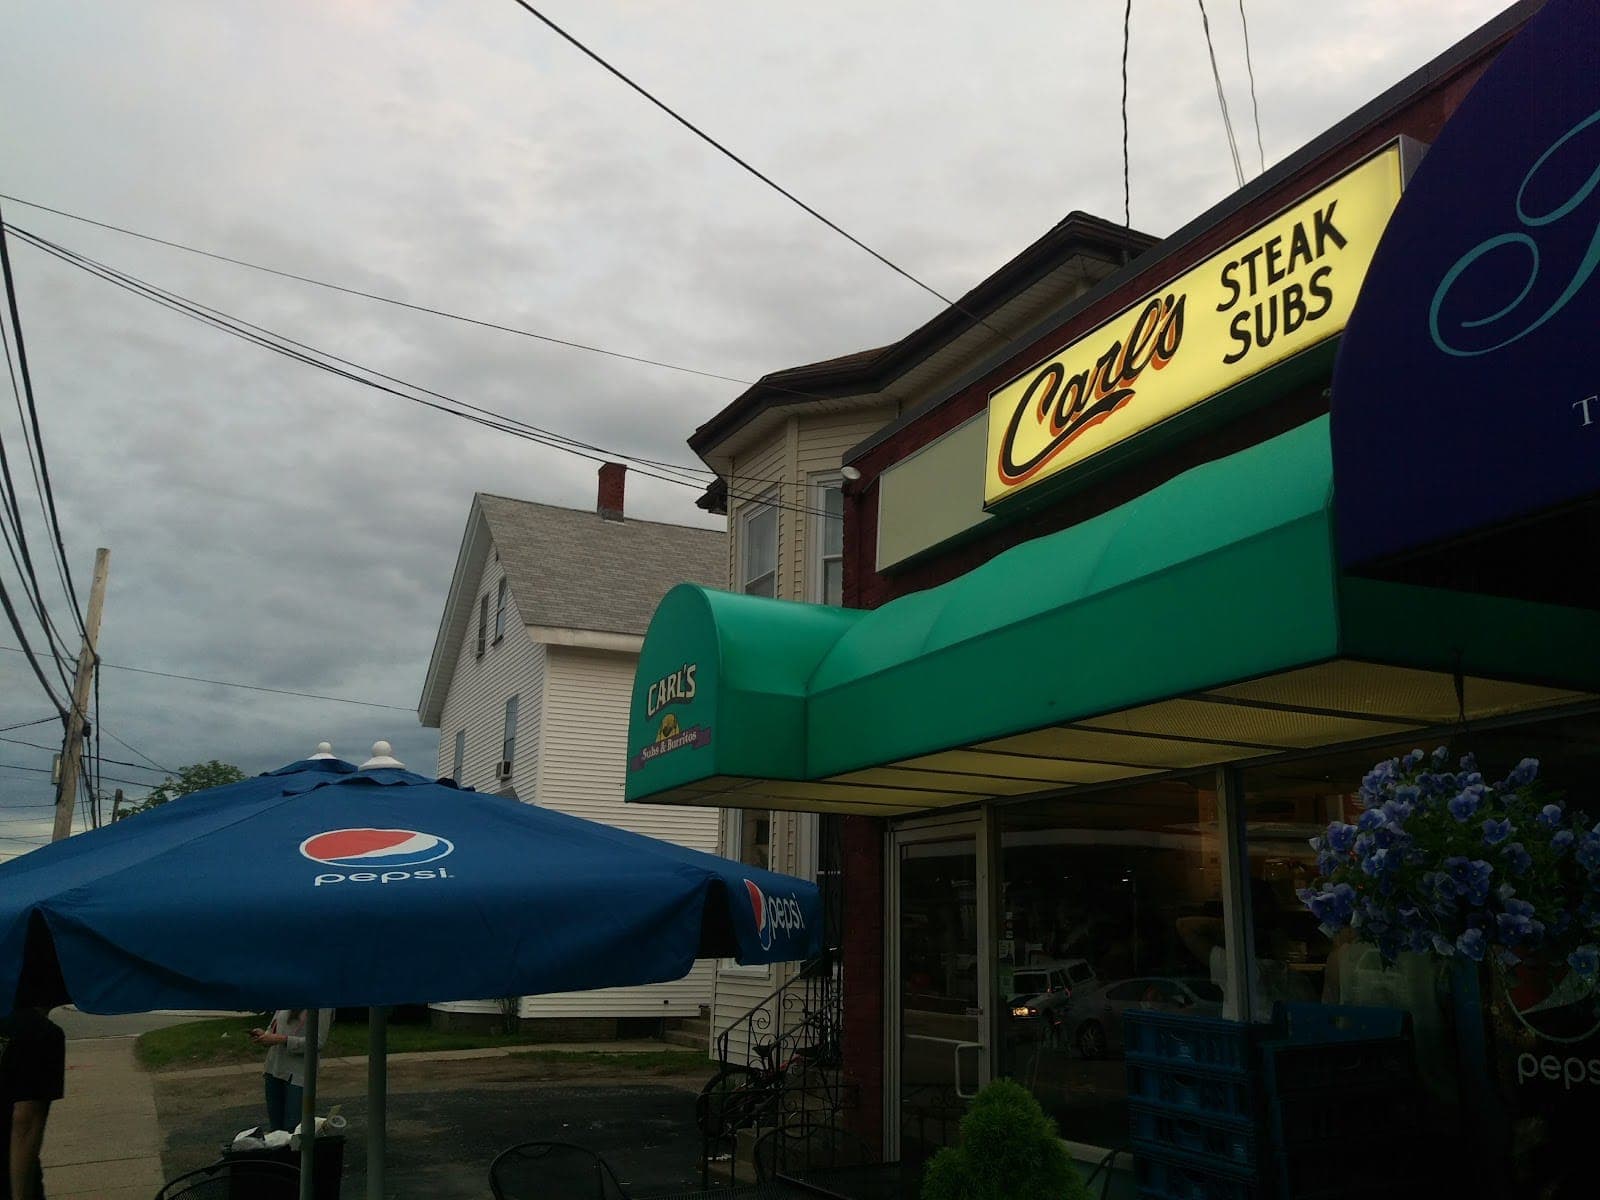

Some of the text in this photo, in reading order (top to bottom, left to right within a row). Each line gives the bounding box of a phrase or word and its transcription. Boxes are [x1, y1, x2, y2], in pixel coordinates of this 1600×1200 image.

[1216, 200, 1348, 312] STEAK
[1222, 266, 1333, 365] SUBS
[999, 293, 1187, 486] Carl's
[647, 663, 697, 717] CARL'S
[641, 731, 697, 761] Subs & Burritos
[314, 867, 448, 887] pepsi
[767, 892, 806, 940] pepsi
